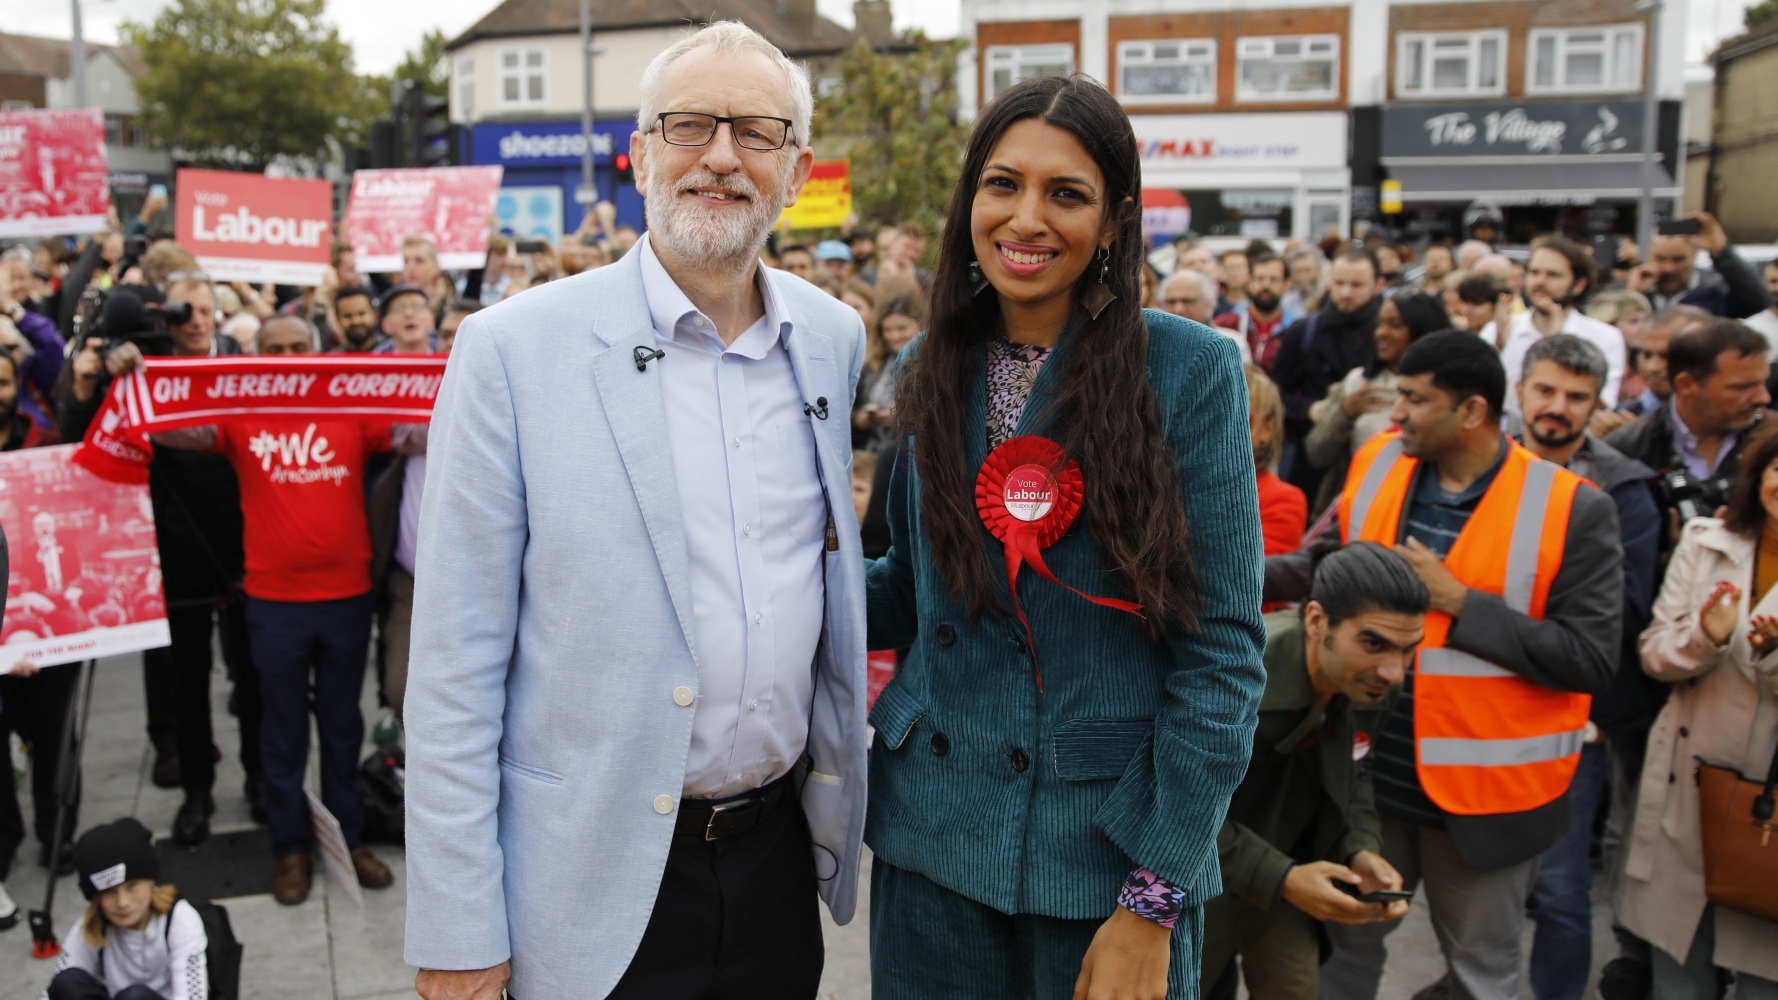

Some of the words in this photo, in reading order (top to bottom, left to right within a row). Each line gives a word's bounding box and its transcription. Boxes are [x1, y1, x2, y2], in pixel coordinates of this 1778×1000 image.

[1424, 111, 1477, 146] The
[1484, 107, 1567, 155] Village
[194, 190, 228, 207] Vote
[193, 205, 328, 248] Labour
[153, 375, 191, 404] OH
[206, 374, 316, 399] JEREMY
[249, 422, 336, 472] #We
[1006, 488, 1051, 500] Labour
[1017, 479, 1037, 488] Vote
